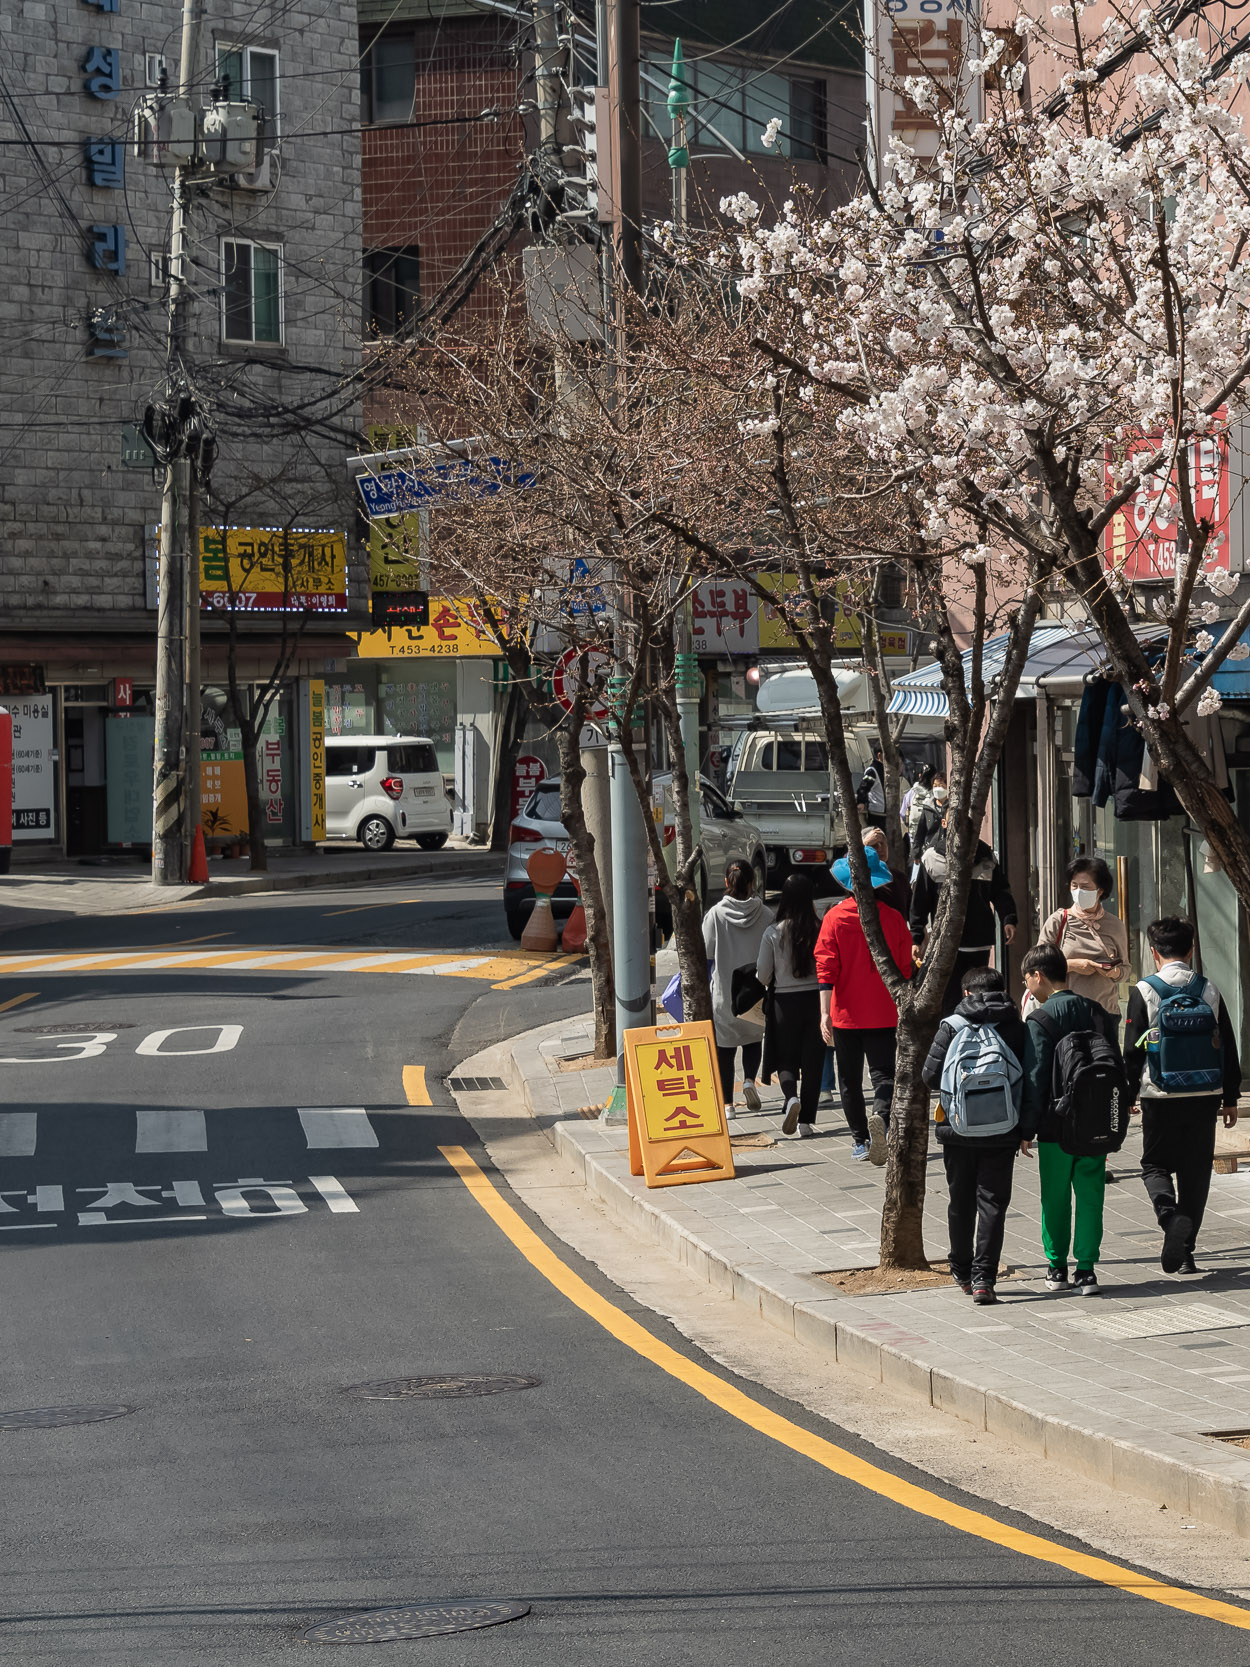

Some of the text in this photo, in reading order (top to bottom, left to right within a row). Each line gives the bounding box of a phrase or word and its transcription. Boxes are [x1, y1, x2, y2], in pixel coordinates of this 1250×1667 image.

[237, 541, 336, 575] 공인중개사
[299, 577, 335, 591] 사무소
[201, 592, 257, 607] -6007
[389, 644, 459, 655] T.453-4238
[23, 703, 49, 719] 미용실
[515, 763, 542, 776] 늘봄
[264, 739, 285, 824] 부동산
[19, 808, 48, 826] 사진 등
[0, 1024, 244, 1063] 30
[654, 1044, 705, 1132] 세탁소
